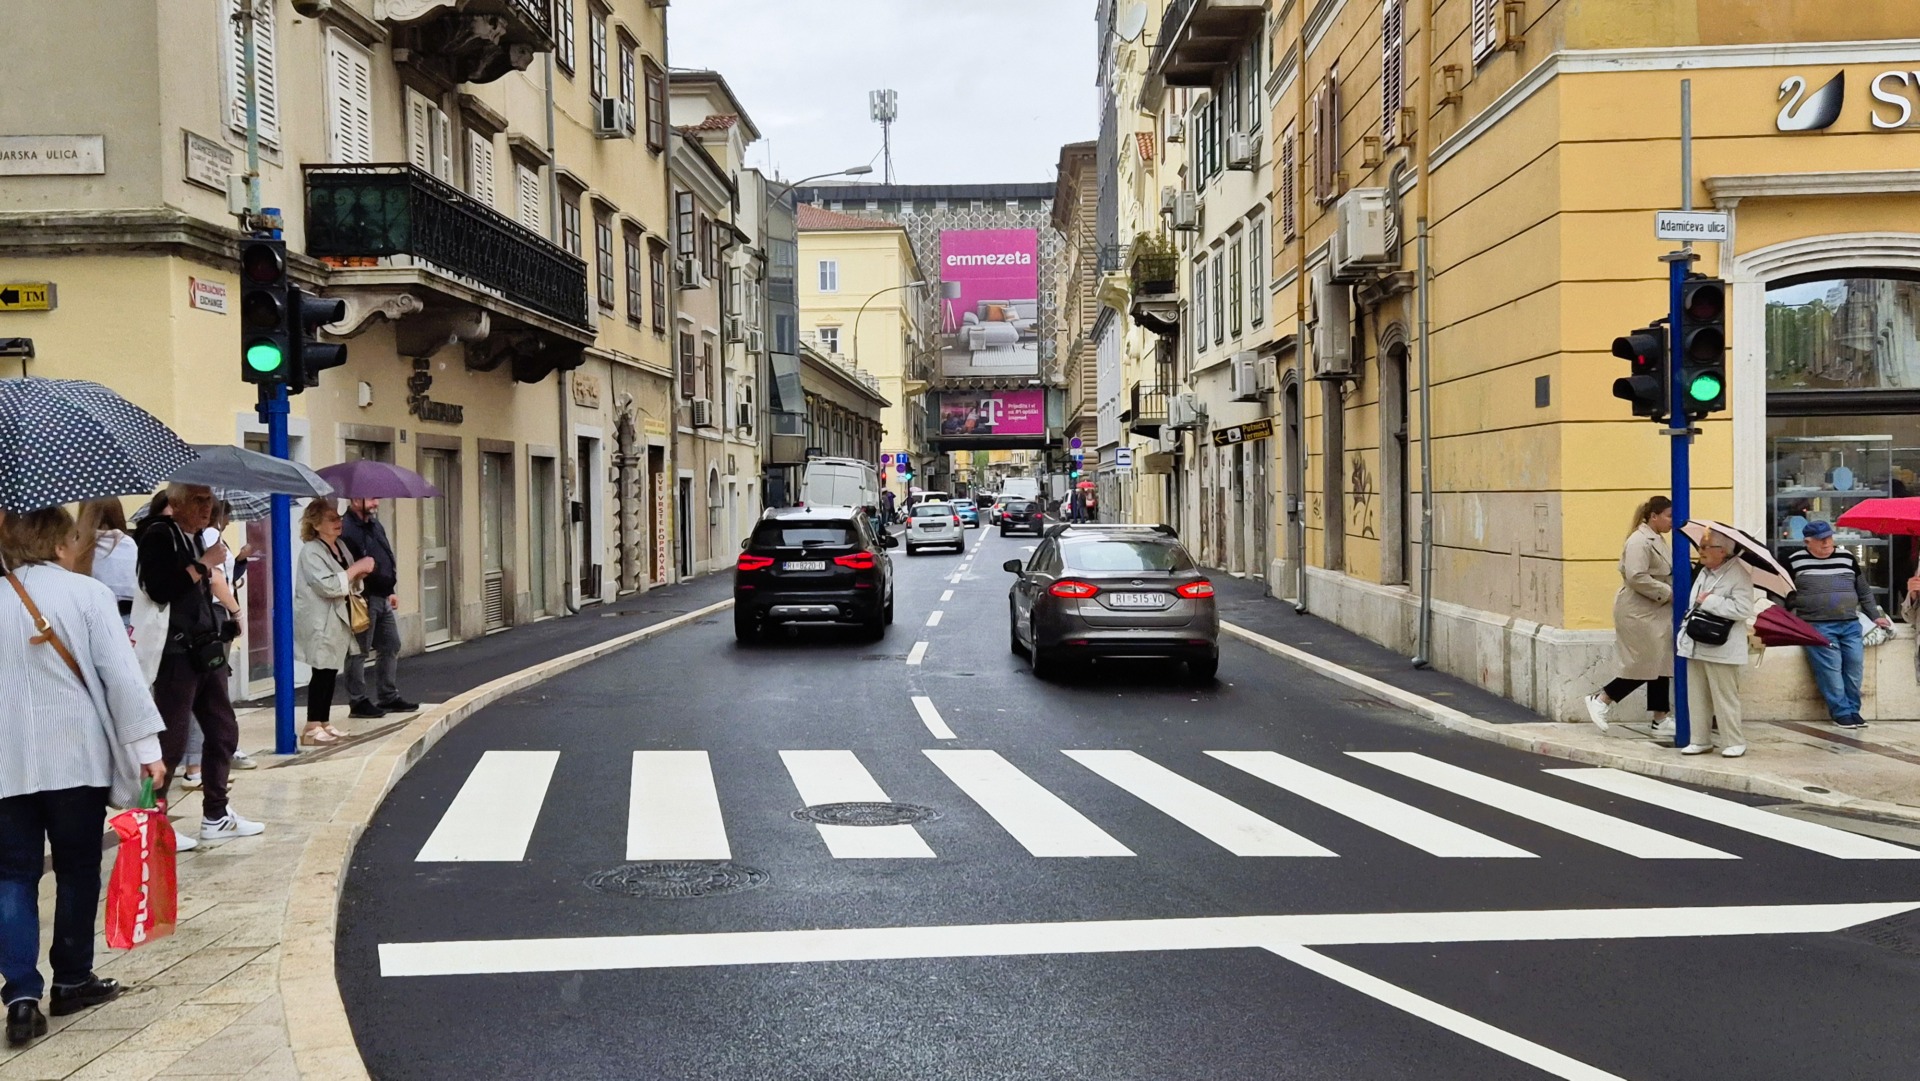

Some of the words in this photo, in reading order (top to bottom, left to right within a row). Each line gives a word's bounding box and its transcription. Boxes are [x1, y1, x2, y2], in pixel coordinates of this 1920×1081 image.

[1871, 70, 1920, 128] S
[46, 150, 78, 159] ULICA
[1660, 220, 1704, 232] Adamićeva
[1707, 221, 1726, 232] ulica
[946, 251, 1031, 266] emmezeta
[23, 291, 45, 302] TM
[658, 529, 666, 583] POPRAVAKA
[1116, 594, 1126, 604] RI
